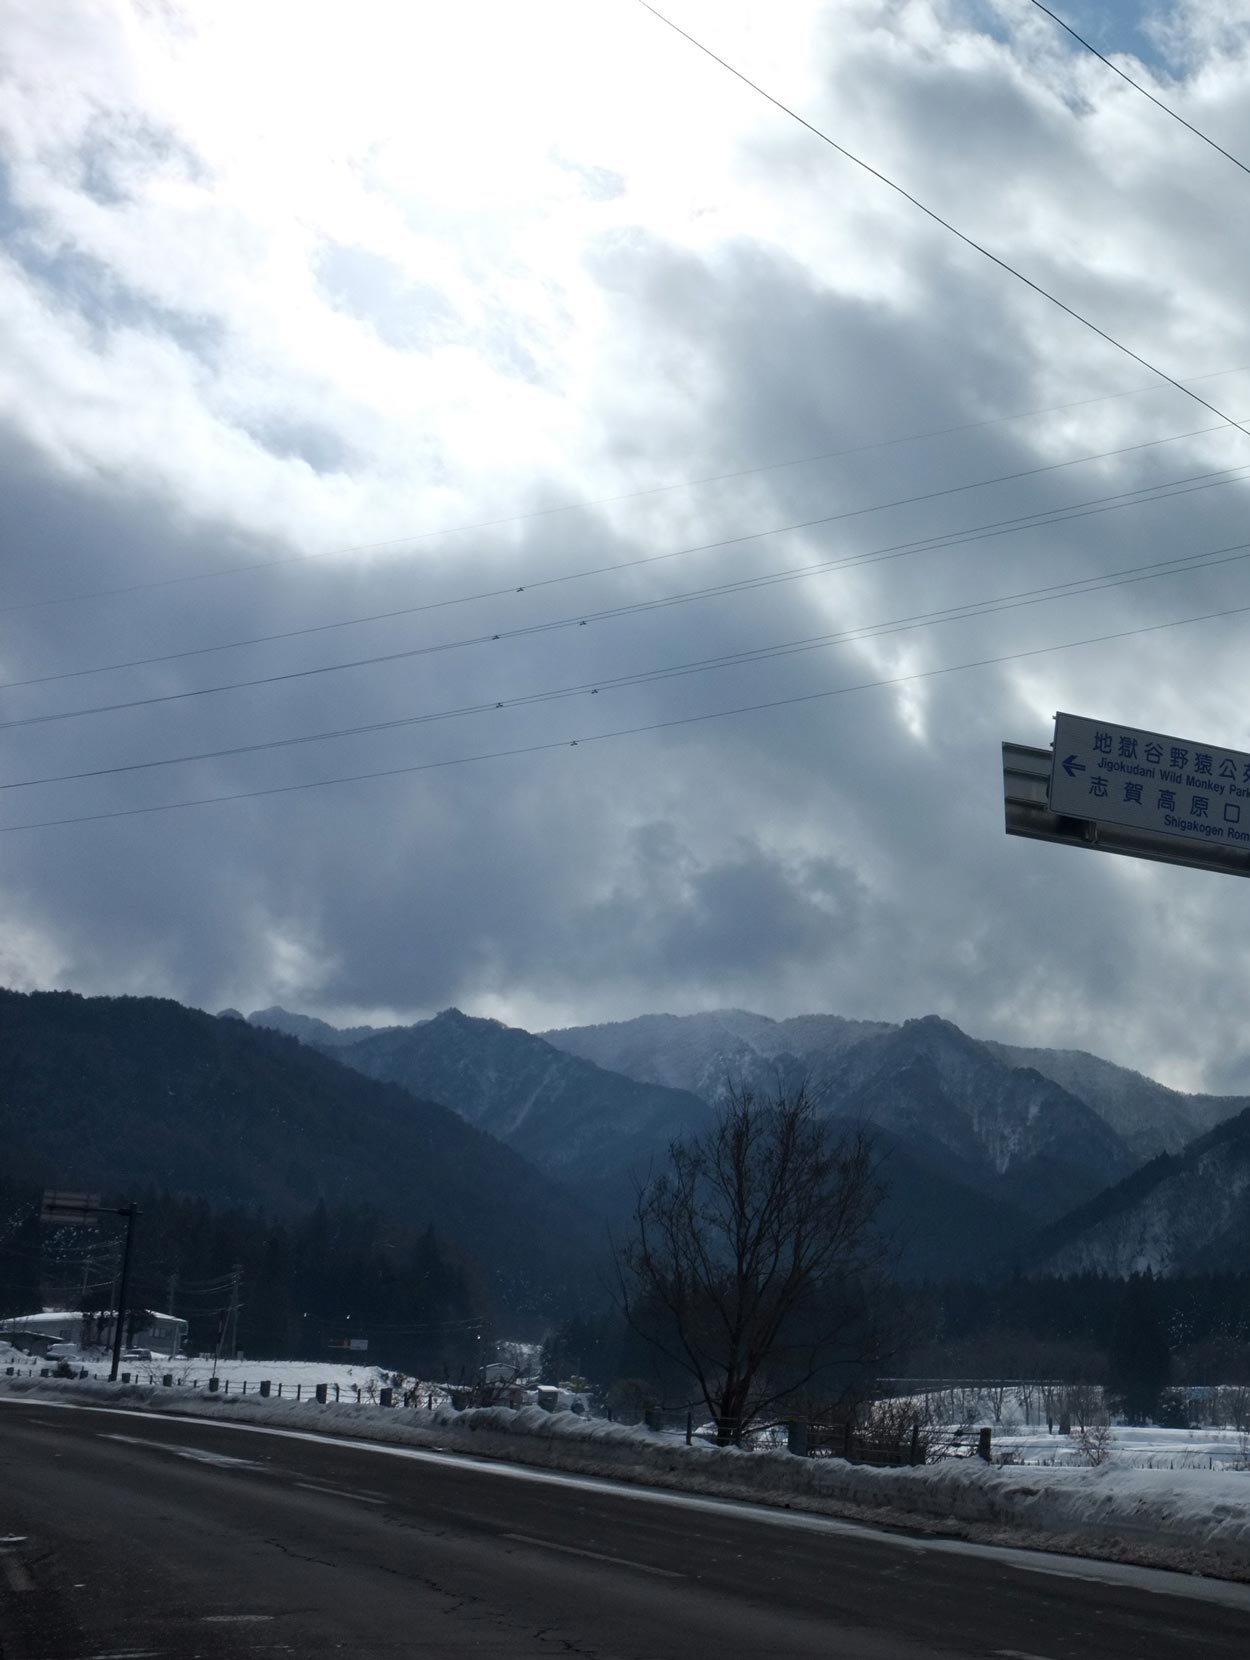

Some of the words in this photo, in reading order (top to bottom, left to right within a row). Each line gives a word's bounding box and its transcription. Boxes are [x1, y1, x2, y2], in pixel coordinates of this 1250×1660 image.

[1098, 758, 1155, 777] Jigokudani
[1160, 768, 1182, 784] Wild
[1186, 775, 1226, 795] Monkey
[1164, 815, 1223, 835] Shigakogen
